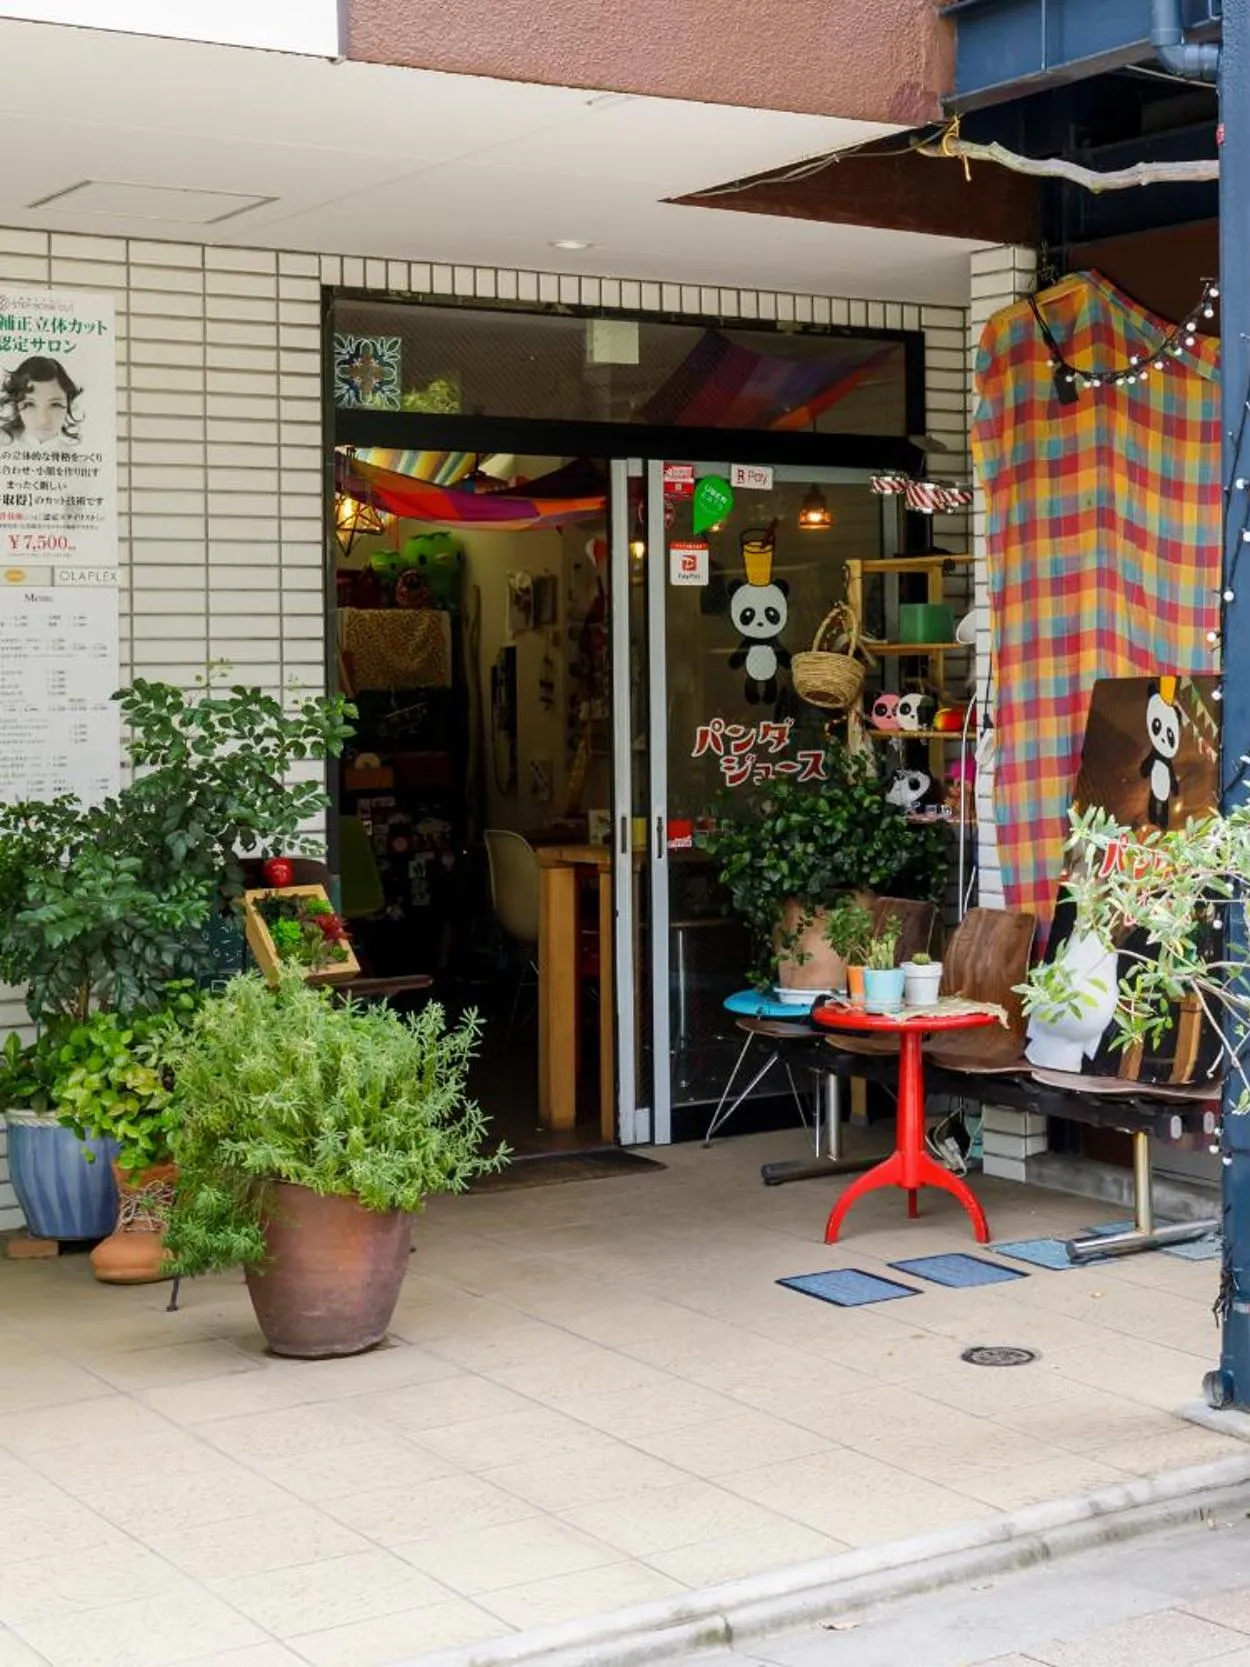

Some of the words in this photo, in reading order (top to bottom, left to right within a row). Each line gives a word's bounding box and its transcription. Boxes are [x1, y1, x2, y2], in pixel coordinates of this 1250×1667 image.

[0, 493, 105, 507] 取得】のカット技術です
[692, 717, 795, 758] パンダ
[719, 749, 829, 787] ジュース
